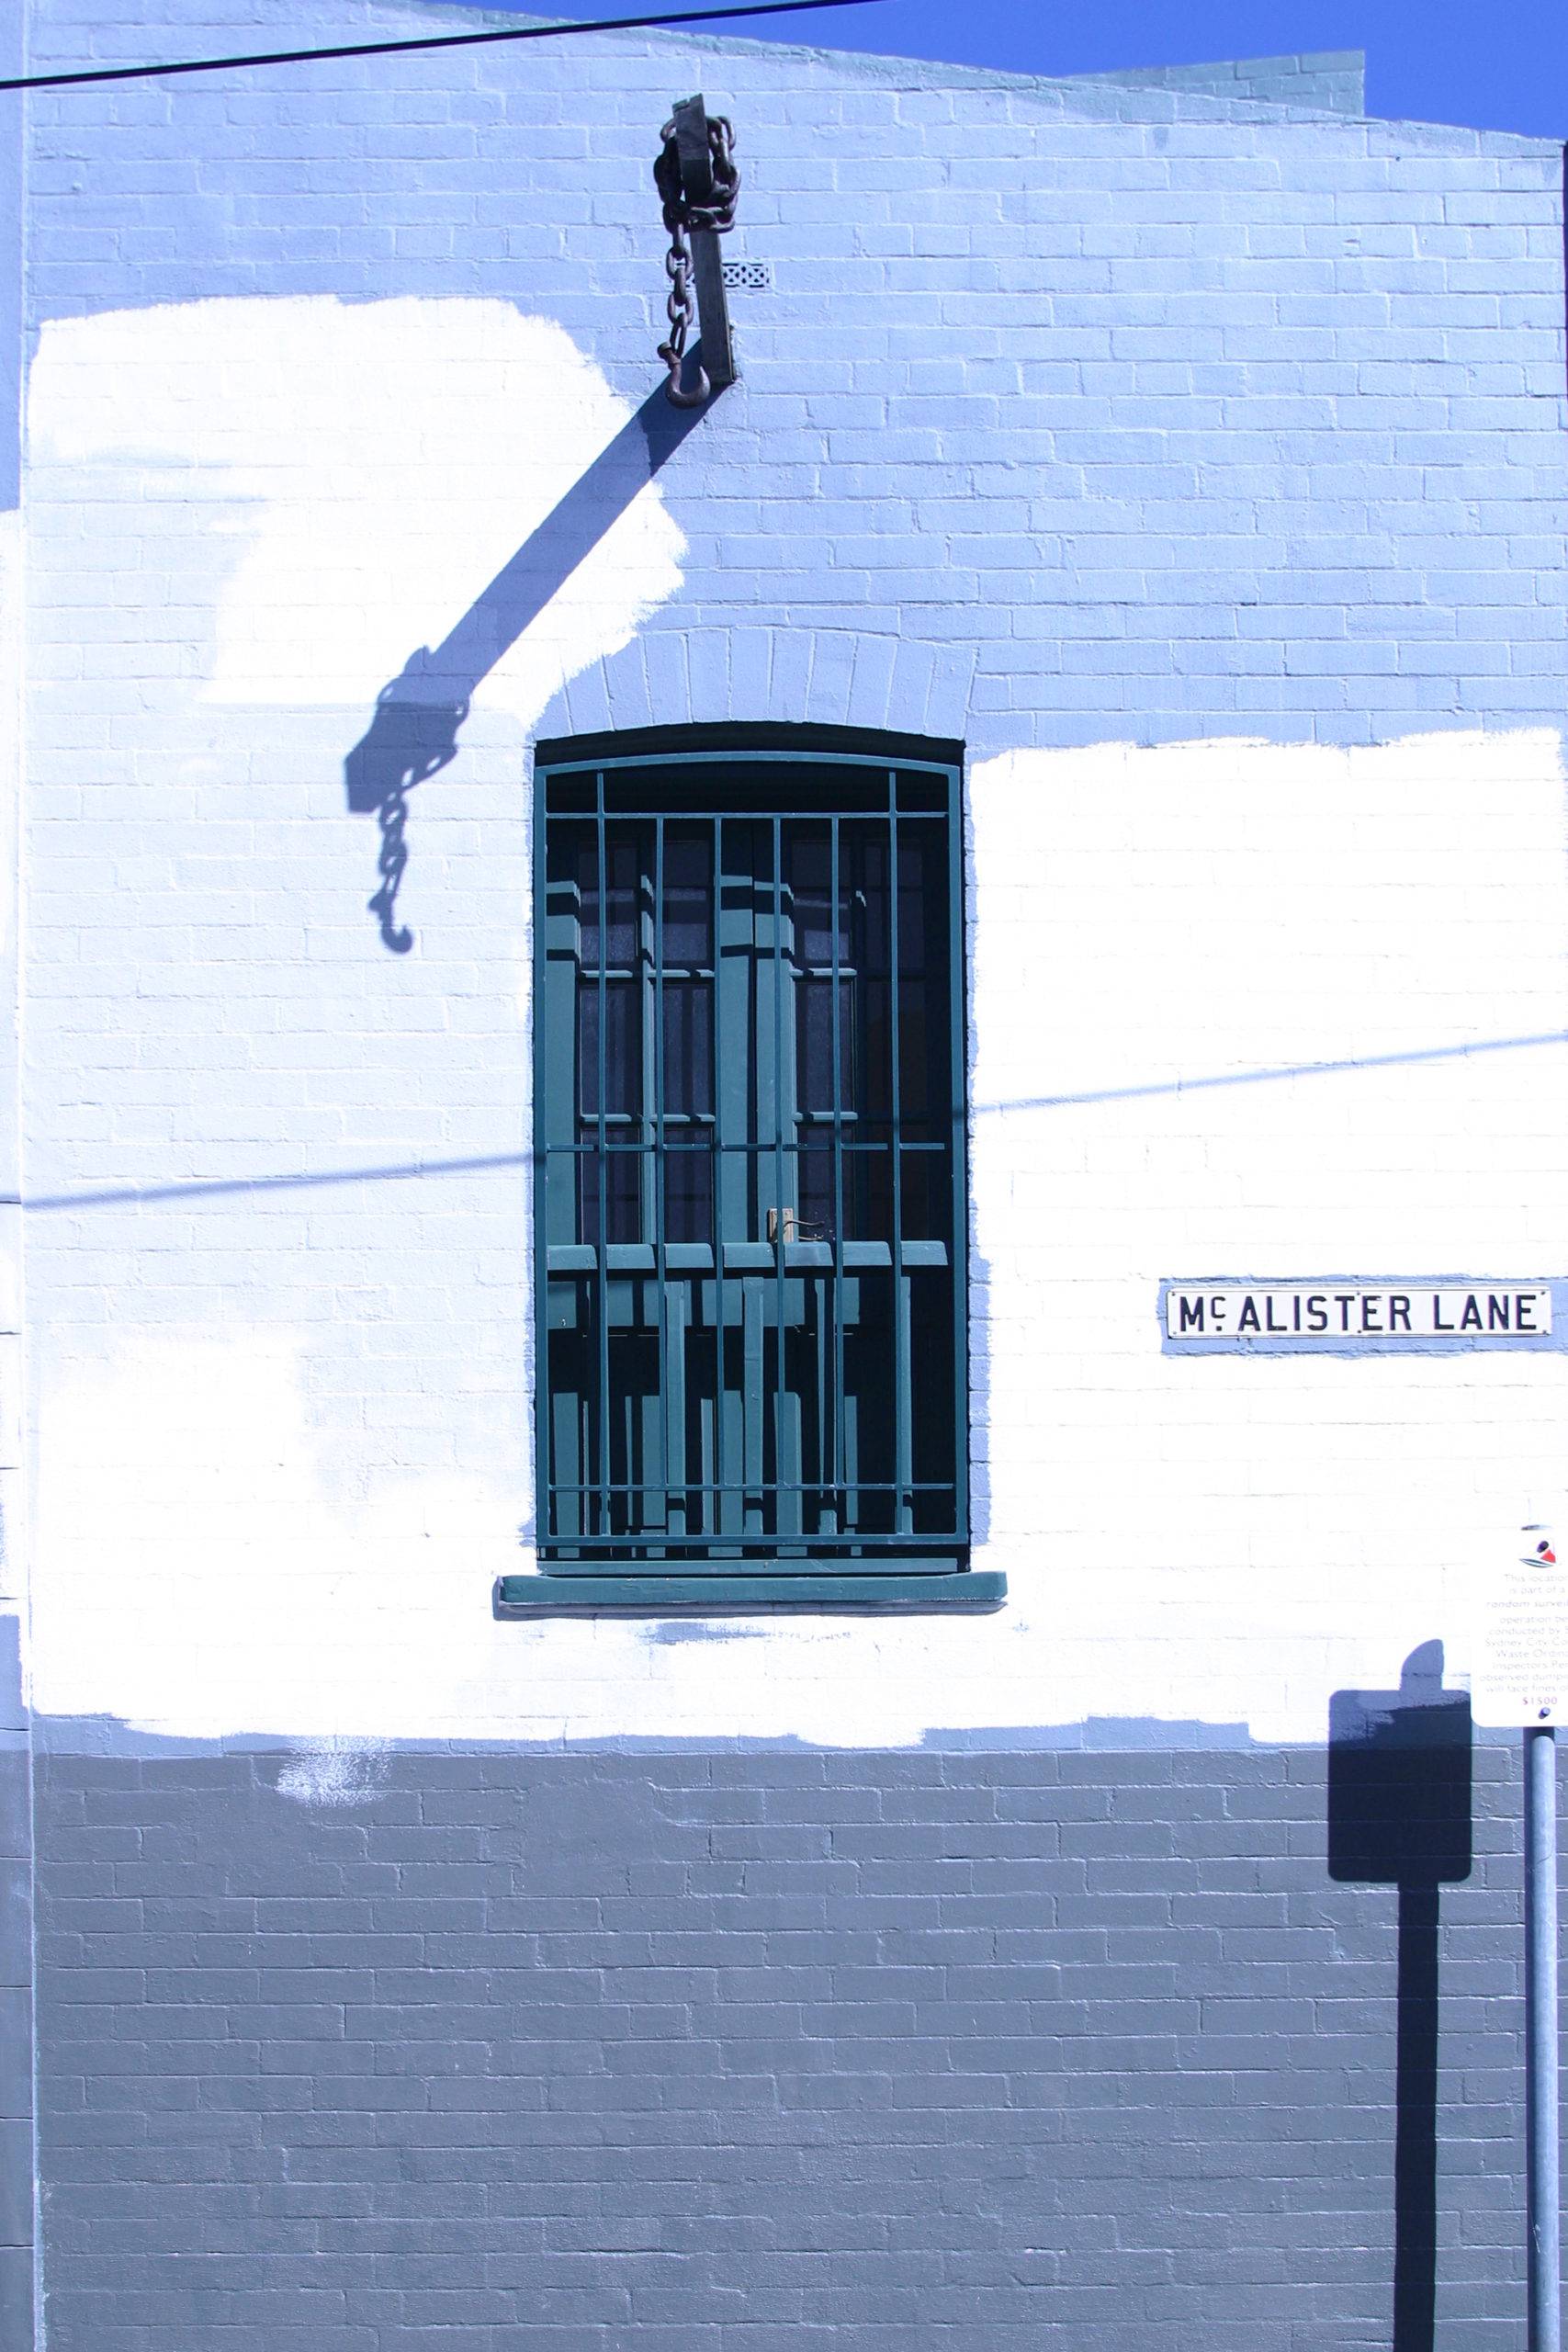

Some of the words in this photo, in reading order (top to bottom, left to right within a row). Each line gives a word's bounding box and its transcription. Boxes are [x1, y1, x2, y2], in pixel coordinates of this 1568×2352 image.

[1433, 1294, 1538, 1331] LANE
[1521, 1587, 1543, 1596] part
[1486, 1600, 1530, 1609] random
[1499, 1615, 1551, 1625] operation
[1488, 1626, 1544, 1635] conducted
[1495, 1649, 1529, 1658] Waste
[1479, 1673, 1529, 1682] observed
[1522, 1695, 1558, 1706] $1500
